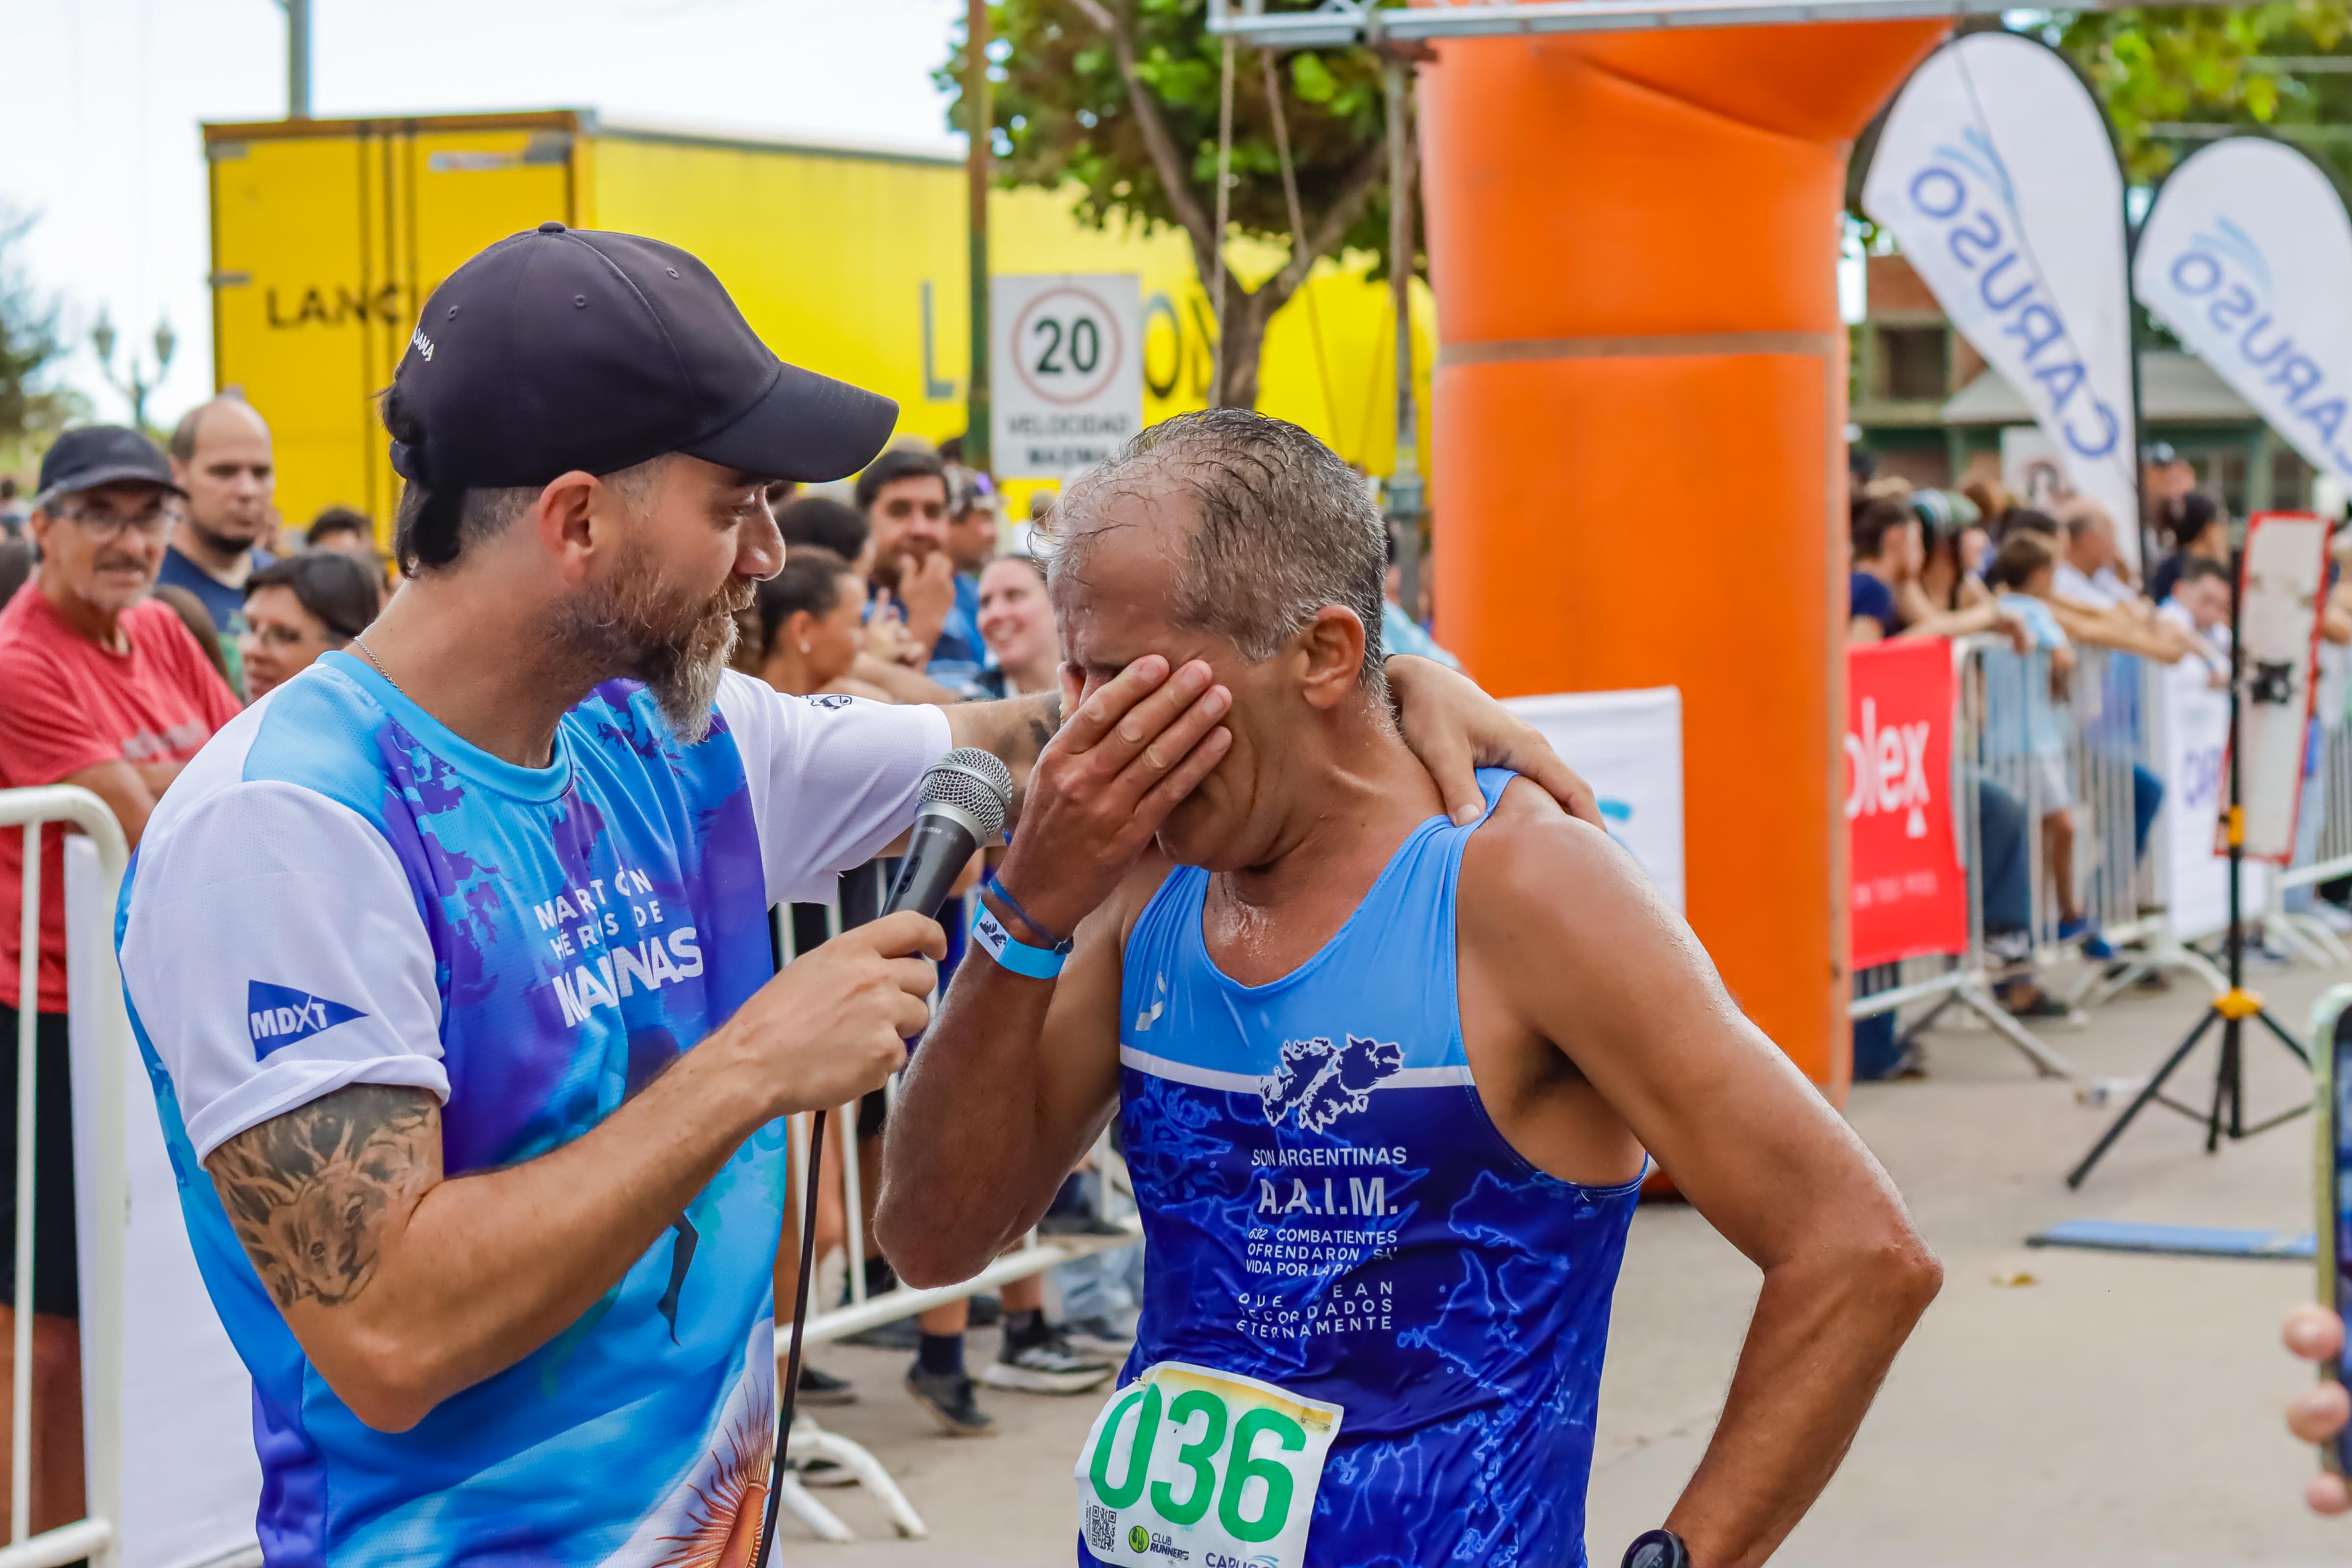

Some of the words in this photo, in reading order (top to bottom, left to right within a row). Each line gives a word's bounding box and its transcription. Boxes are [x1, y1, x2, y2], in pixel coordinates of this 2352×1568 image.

[1034, 317, 1100, 373] 20
[633, 900, 663, 928] DE
[251, 994, 327, 1039] MDXT
[1251, 1149, 1276, 1166] SON
[1279, 1147, 1407, 1166] ARGENTINAS
[1258, 1177, 1397, 1216] A.A.I.M.
[1276, 1228, 1397, 1245] COMBATIENTES
[1248, 1243, 1359, 1261] OFRENDARON
[1246, 1260, 1272, 1274] VIDA
[1276, 1262, 1308, 1276] POR
[1312, 1264, 1330, 1276] LA
[1236, 1316, 1391, 1339] ETERNAMENTE
[1090, 1382, 1306, 1542] 036
[1152, 1533, 1172, 1545] CLUB
